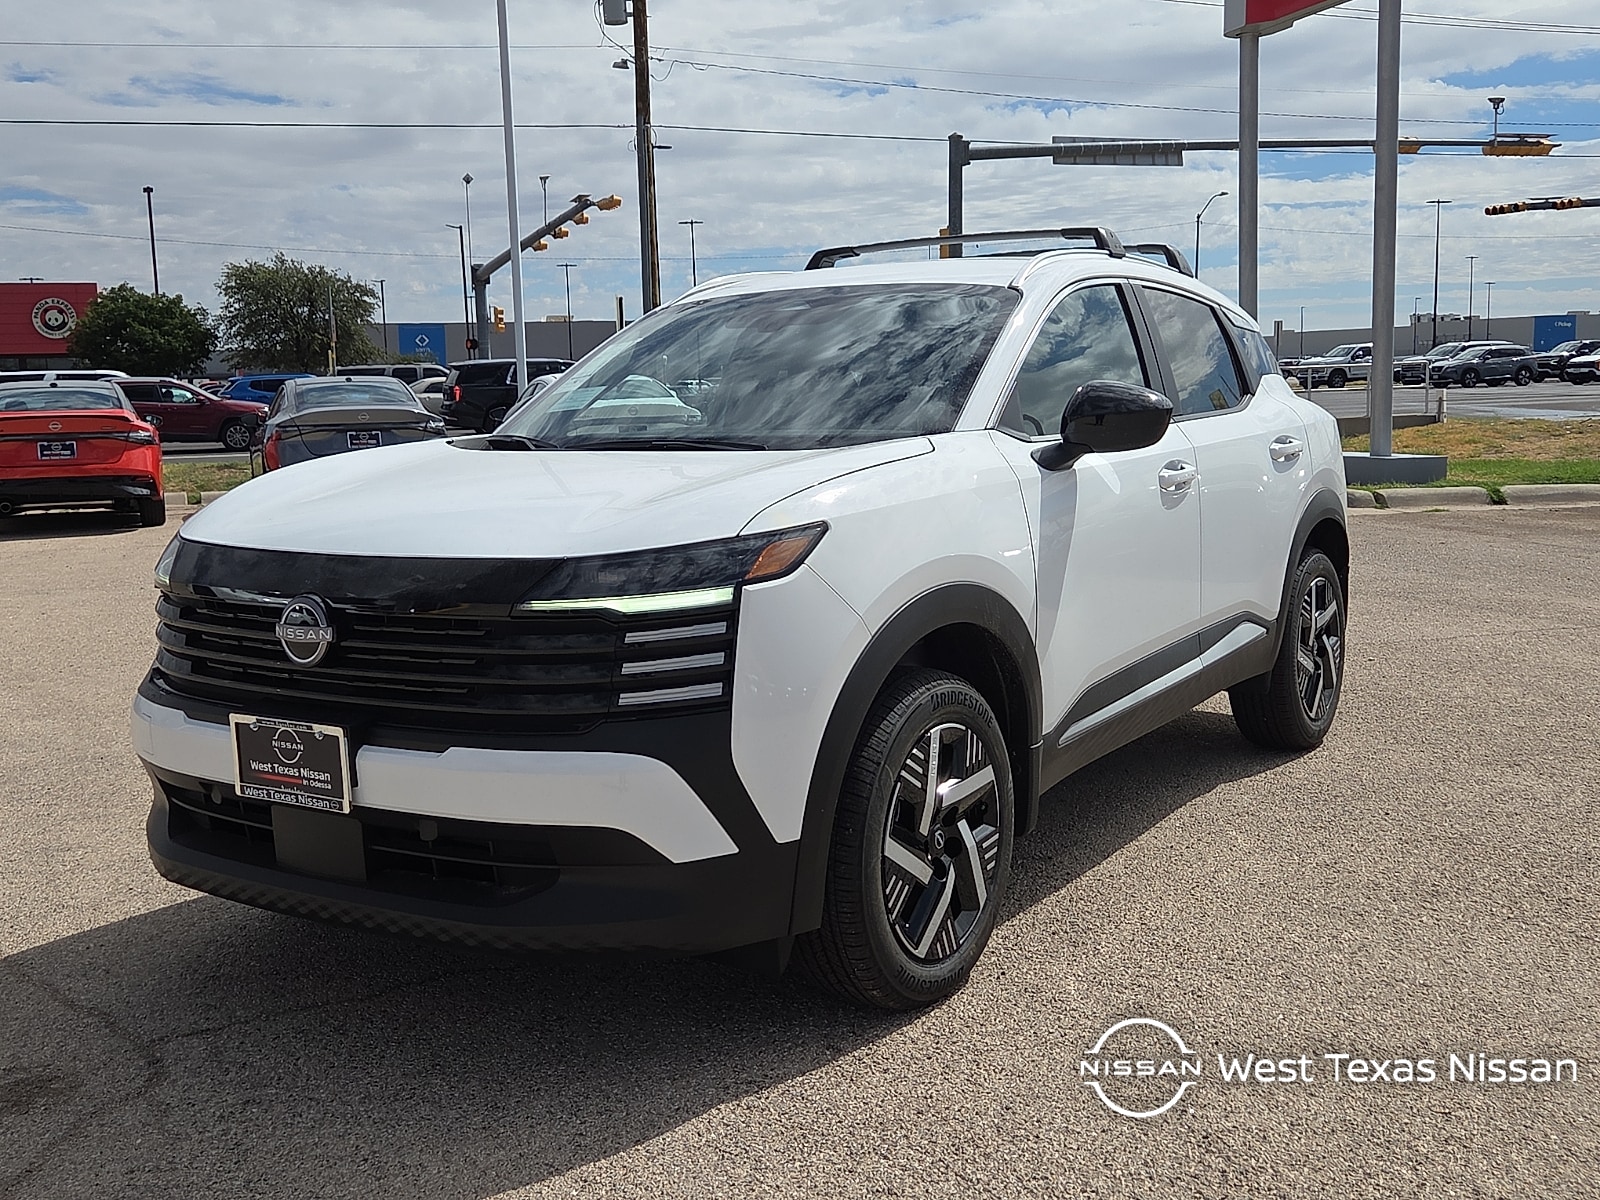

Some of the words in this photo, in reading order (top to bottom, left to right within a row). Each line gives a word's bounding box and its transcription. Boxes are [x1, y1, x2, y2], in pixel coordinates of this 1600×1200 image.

[33, 300, 50, 319] PANDA
[51, 299, 75, 320] EXPRESS
[275, 625, 330, 640] NISSAN
[930, 690, 993, 728] BRIDGESTONE
[271, 740, 304, 751] NISSAN
[250, 760, 272, 772] West
[273, 764, 299, 777] Texas
[300, 767, 331, 781] Nissan
[310, 779, 331, 789] Odessa
[243, 786, 269, 799] West
[269, 790, 297, 803] Texas
[298, 794, 330, 808] Nissan
